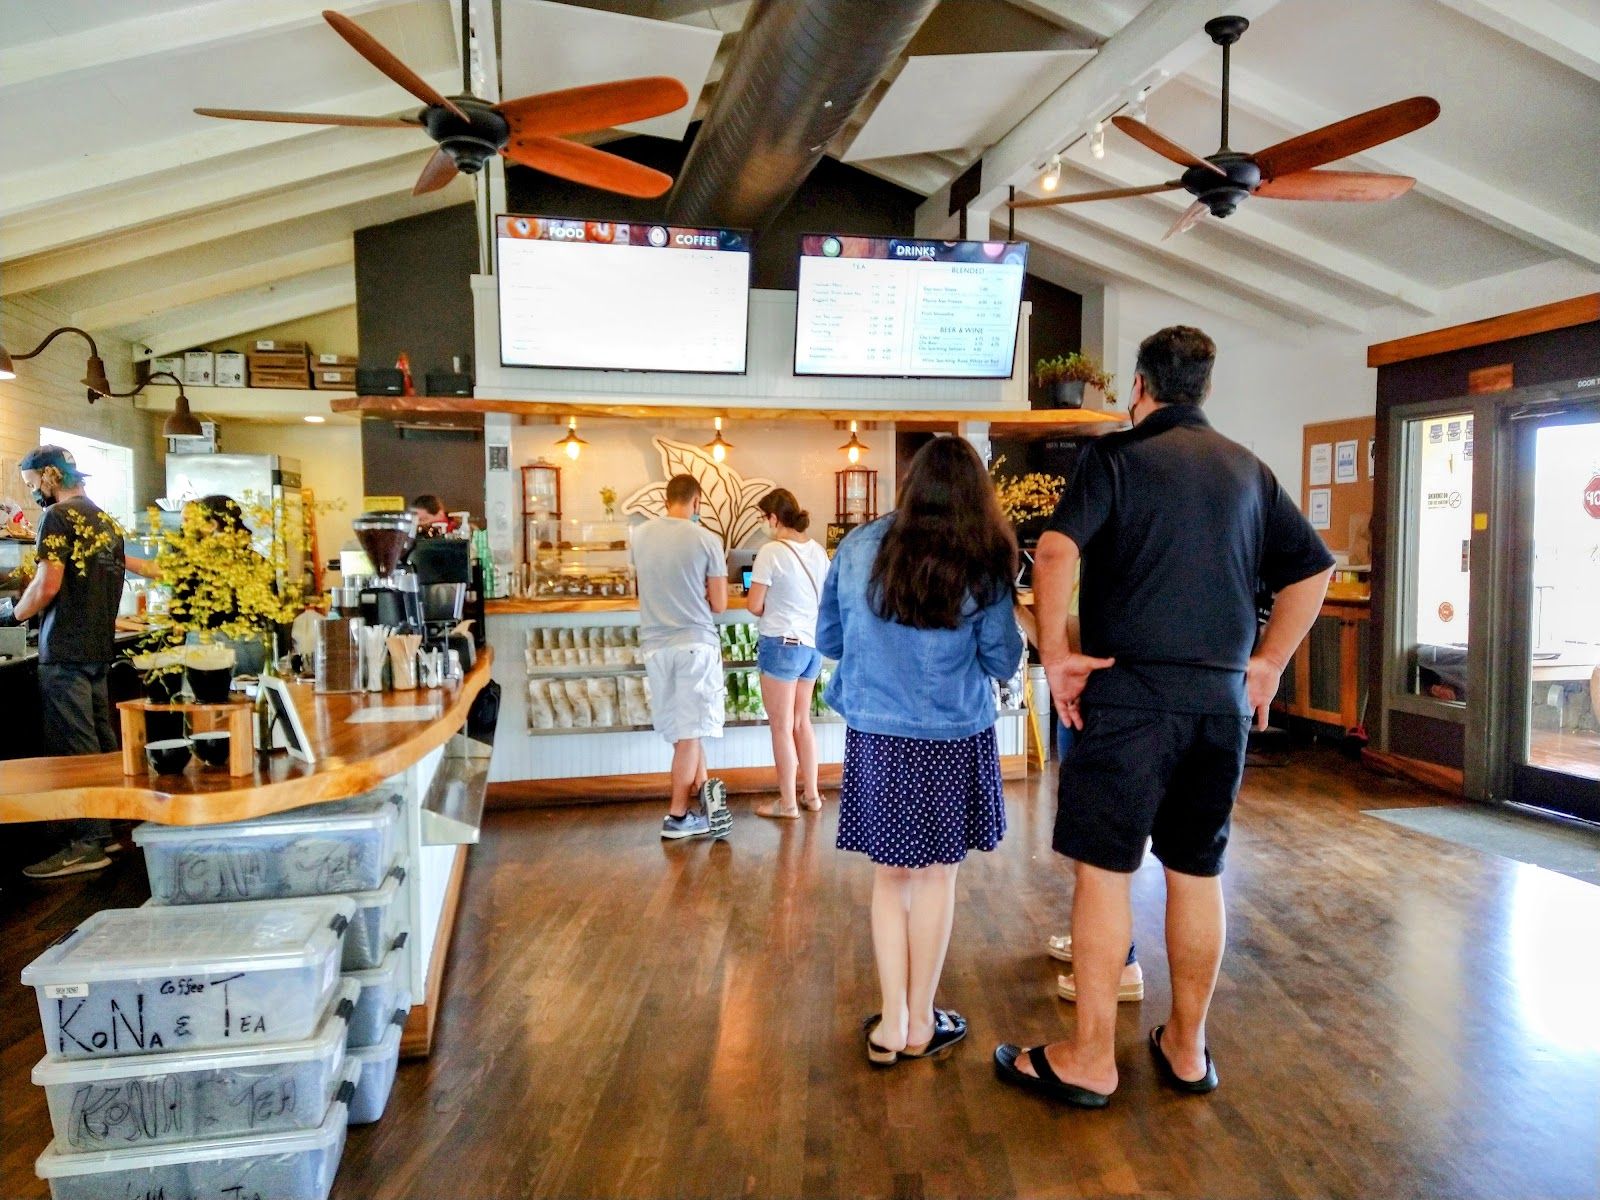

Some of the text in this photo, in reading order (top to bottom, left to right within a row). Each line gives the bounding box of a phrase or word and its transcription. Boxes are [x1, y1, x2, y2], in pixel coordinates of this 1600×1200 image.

[549, 227, 585, 239] FOOD
[675, 234, 718, 247] COFFEE
[896, 245, 936, 257] DRINKS
[951, 267, 985, 275] BLENDED
[940, 326, 957, 334] BEER
[160, 977, 204, 995] Coffee
